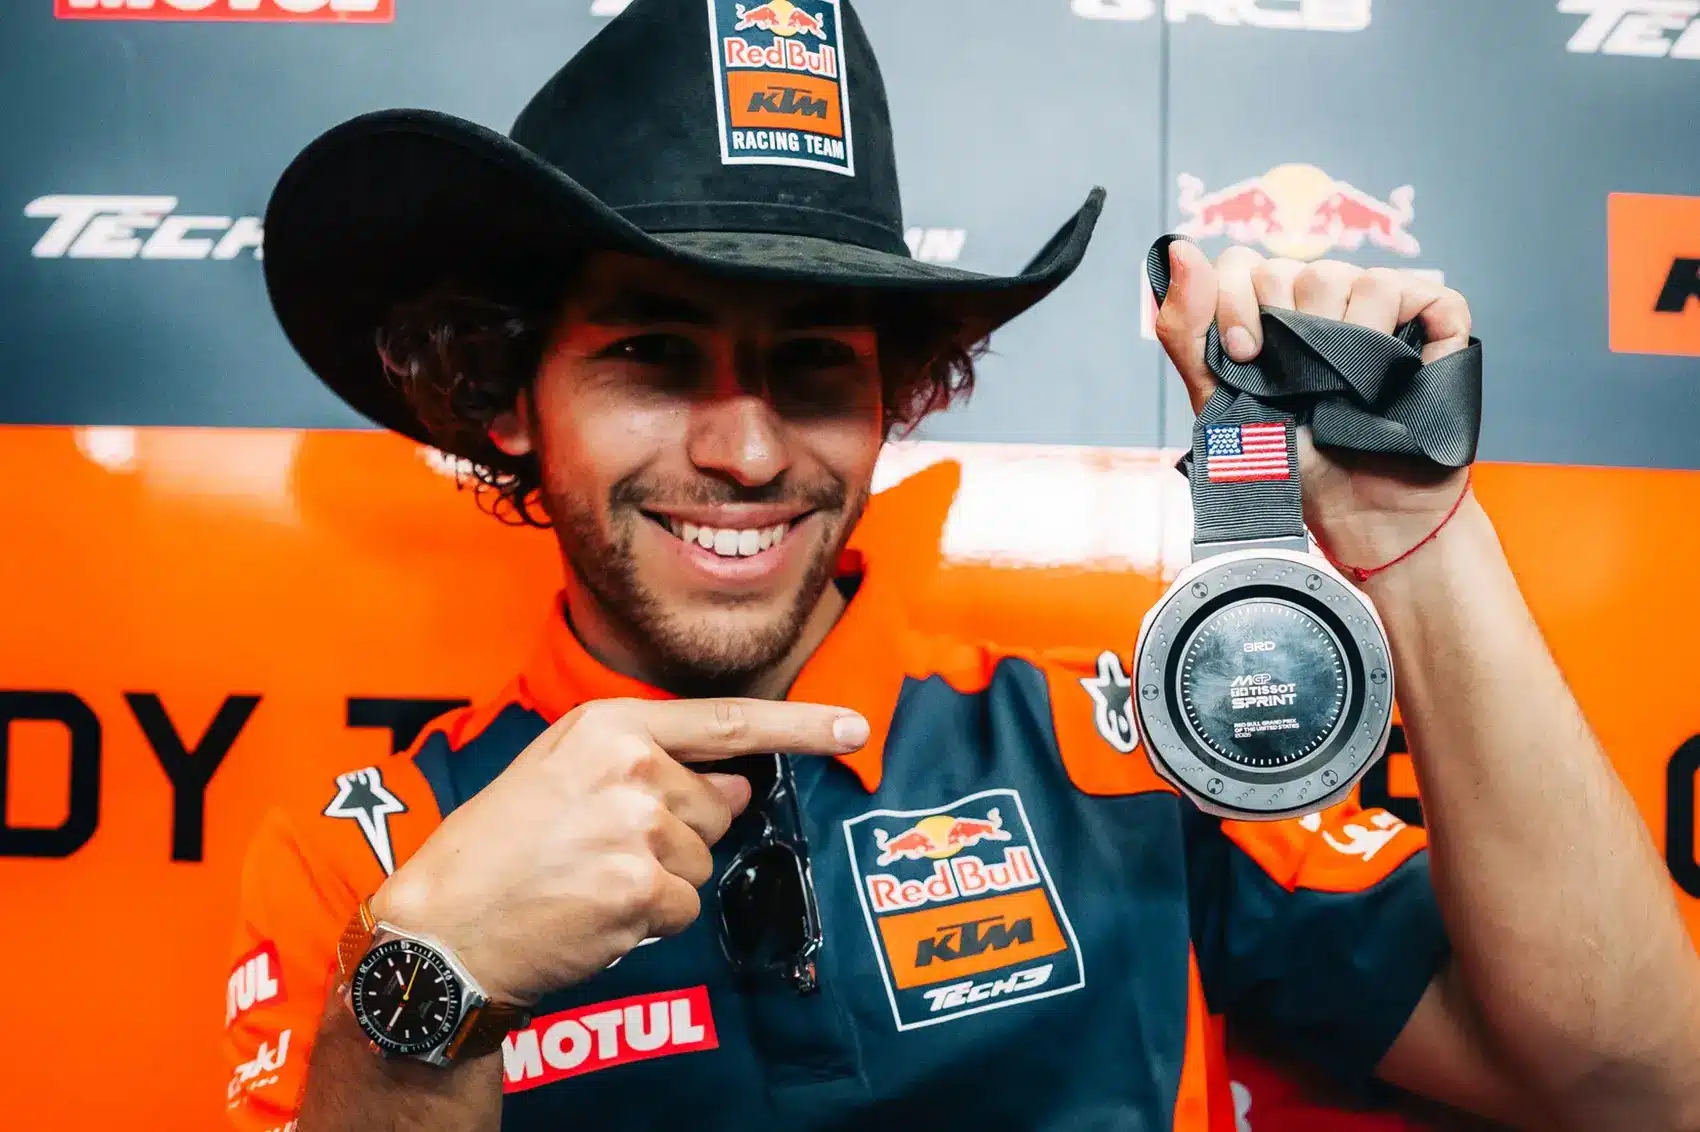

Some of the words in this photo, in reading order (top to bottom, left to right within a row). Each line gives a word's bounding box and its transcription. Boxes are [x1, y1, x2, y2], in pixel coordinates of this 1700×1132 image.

[725, 38, 785, 67] Red
[787, 40, 836, 77] Bull
[747, 86, 828, 120] KTM
[732, 131, 800, 152] RACING
[804, 134, 844, 160] TEAM
[1243, 641, 1275, 652] 3RD
[1232, 693, 1297, 709] SPRINT
[1249, 683, 1296, 696] TISSOT
[1278, 722, 1300, 730] STATES
[868, 861, 957, 911] Red
[952, 848, 1038, 894] Bull
[914, 915, 1034, 968] KTM
[501, 998, 705, 1083] MOTUL
